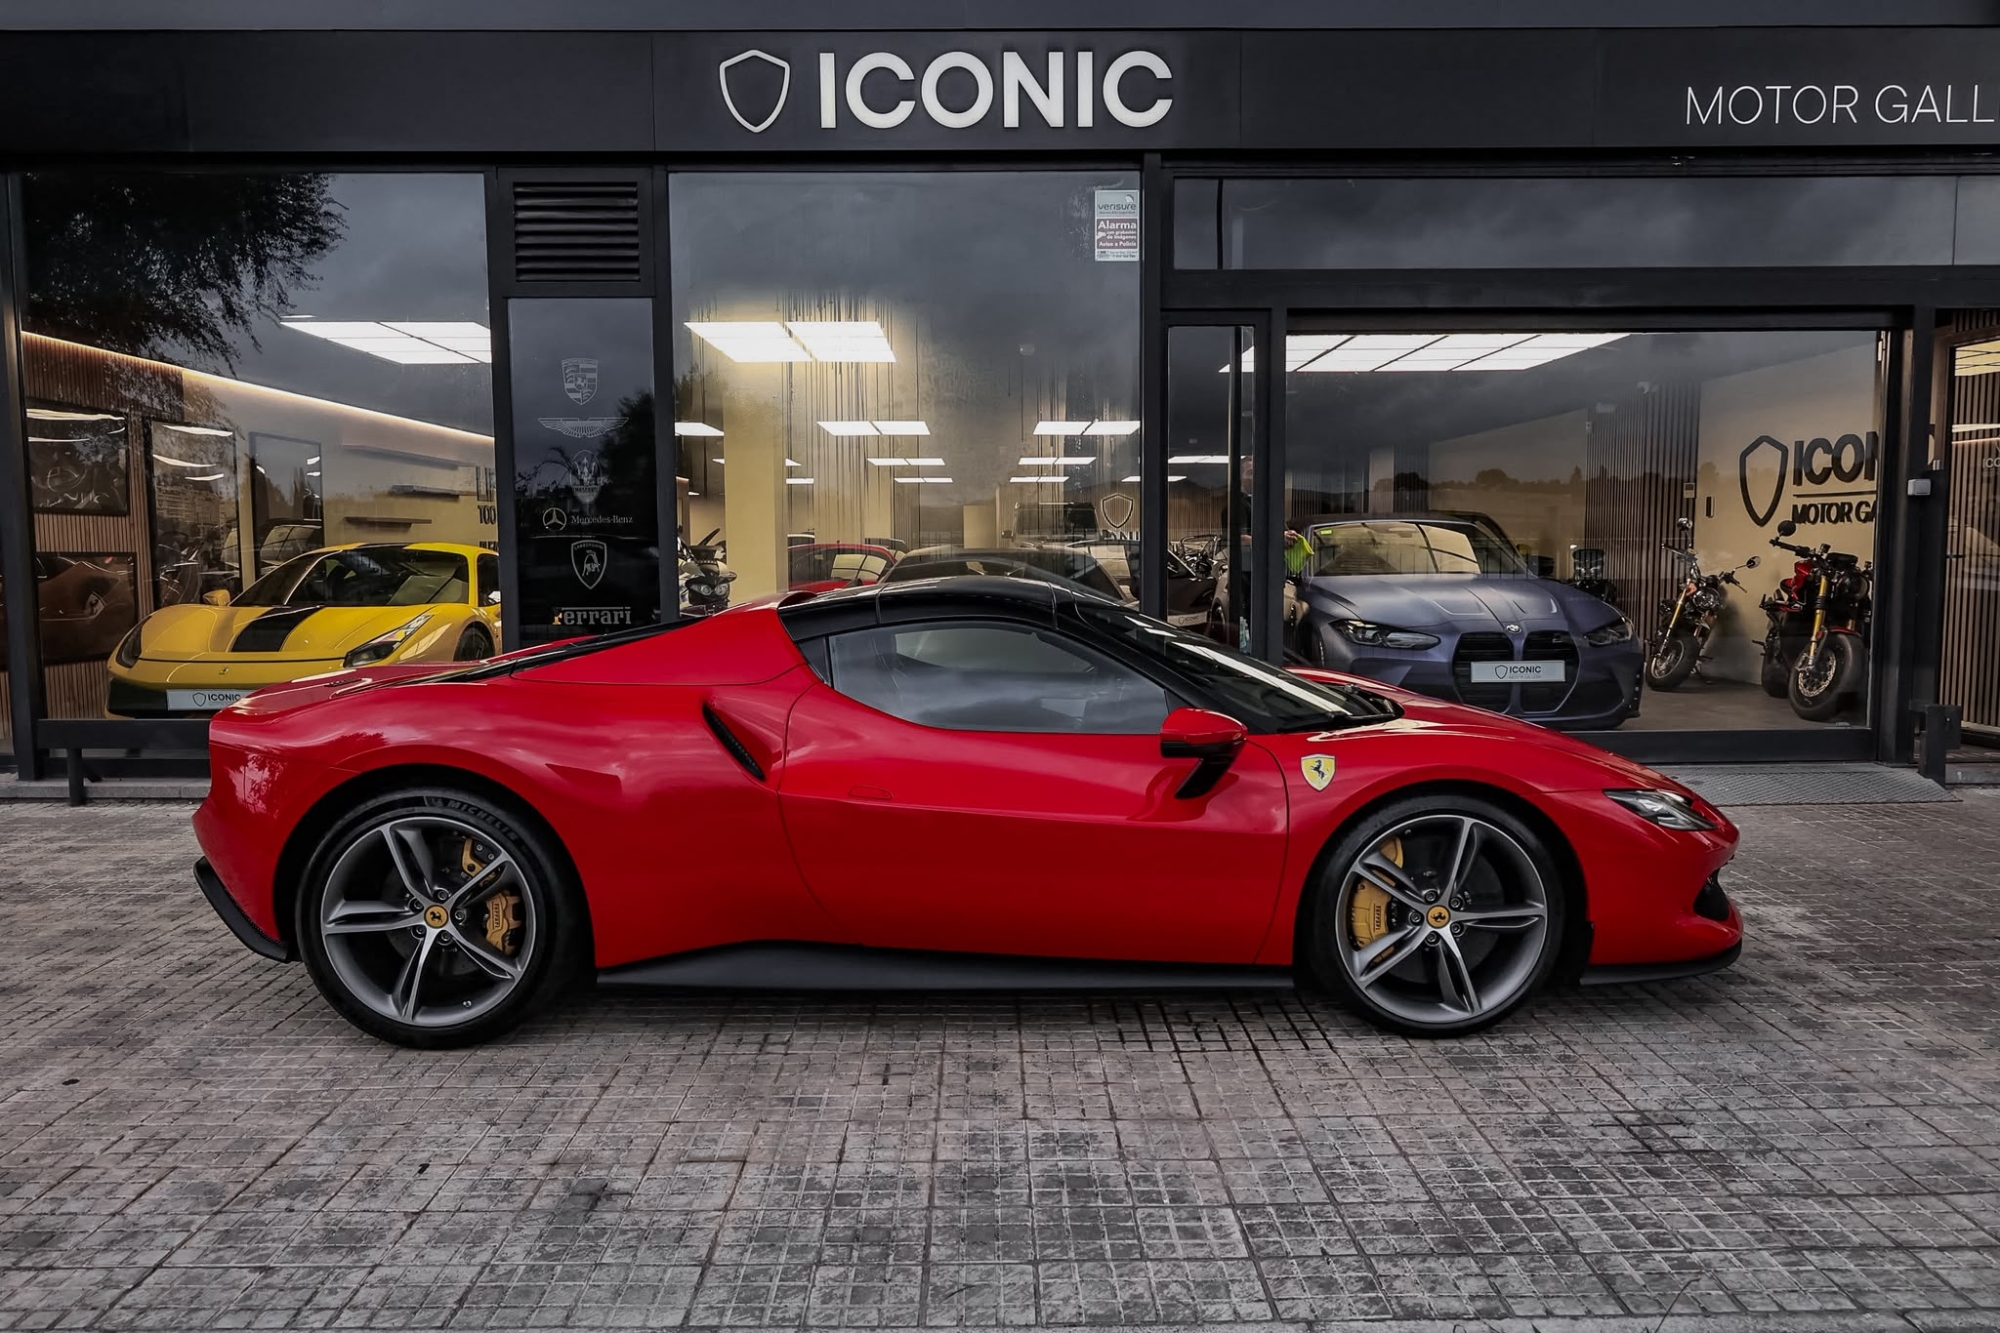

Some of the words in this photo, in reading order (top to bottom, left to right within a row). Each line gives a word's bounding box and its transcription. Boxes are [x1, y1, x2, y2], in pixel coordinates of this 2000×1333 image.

[819, 50, 1173, 128] ICONIC
[1686, 85, 1859, 125] MOTOR
[1874, 84, 1995, 124] GALL
[1098, 219, 1137, 229] Alarma
[1791, 502, 1854, 524] MOTOR
[571, 514, 634, 525] Mercedes-Benz
[1509, 665, 1542, 674] ICONIC
[208, 693, 241, 701] ICONIC
